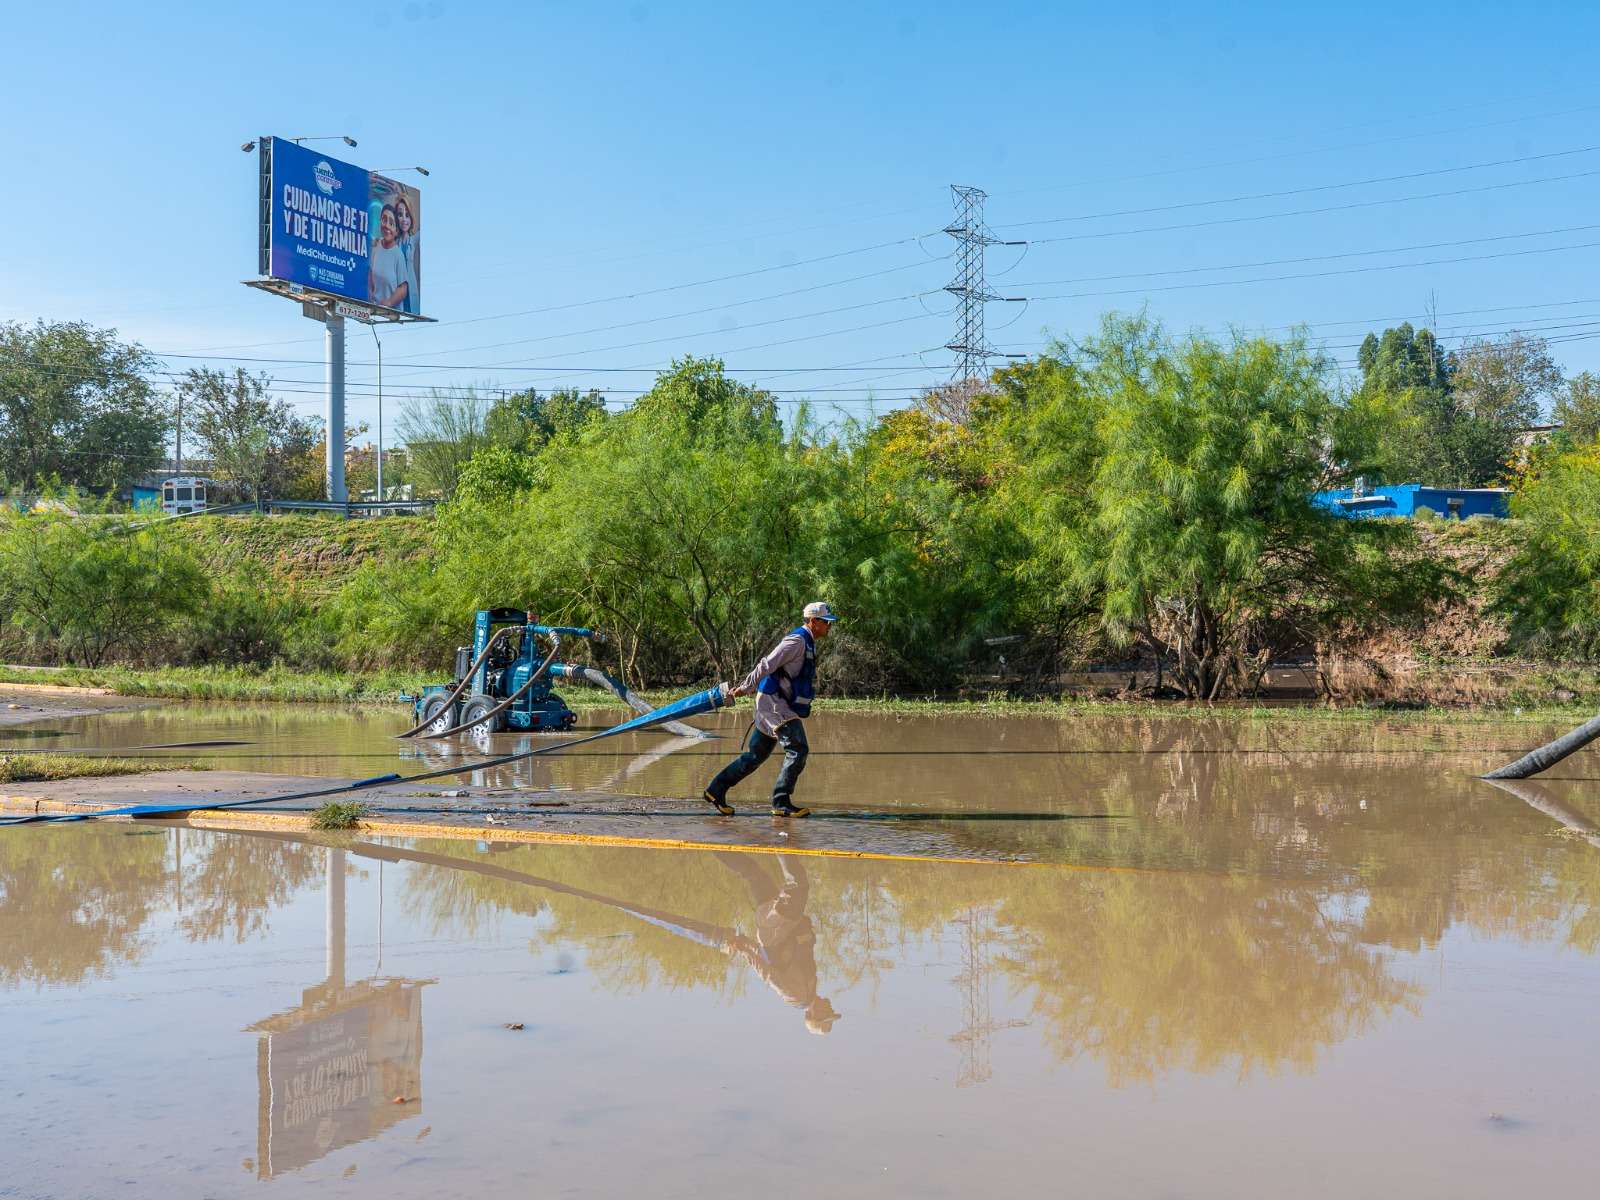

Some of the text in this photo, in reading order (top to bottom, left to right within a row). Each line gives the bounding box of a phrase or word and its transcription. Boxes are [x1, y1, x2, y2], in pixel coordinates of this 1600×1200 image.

[283, 183, 369, 234] CUIDAMOS DE TI
[283, 209, 369, 258] Y DE TU FAMILIA
[296, 243, 347, 267] MediChihuahua
